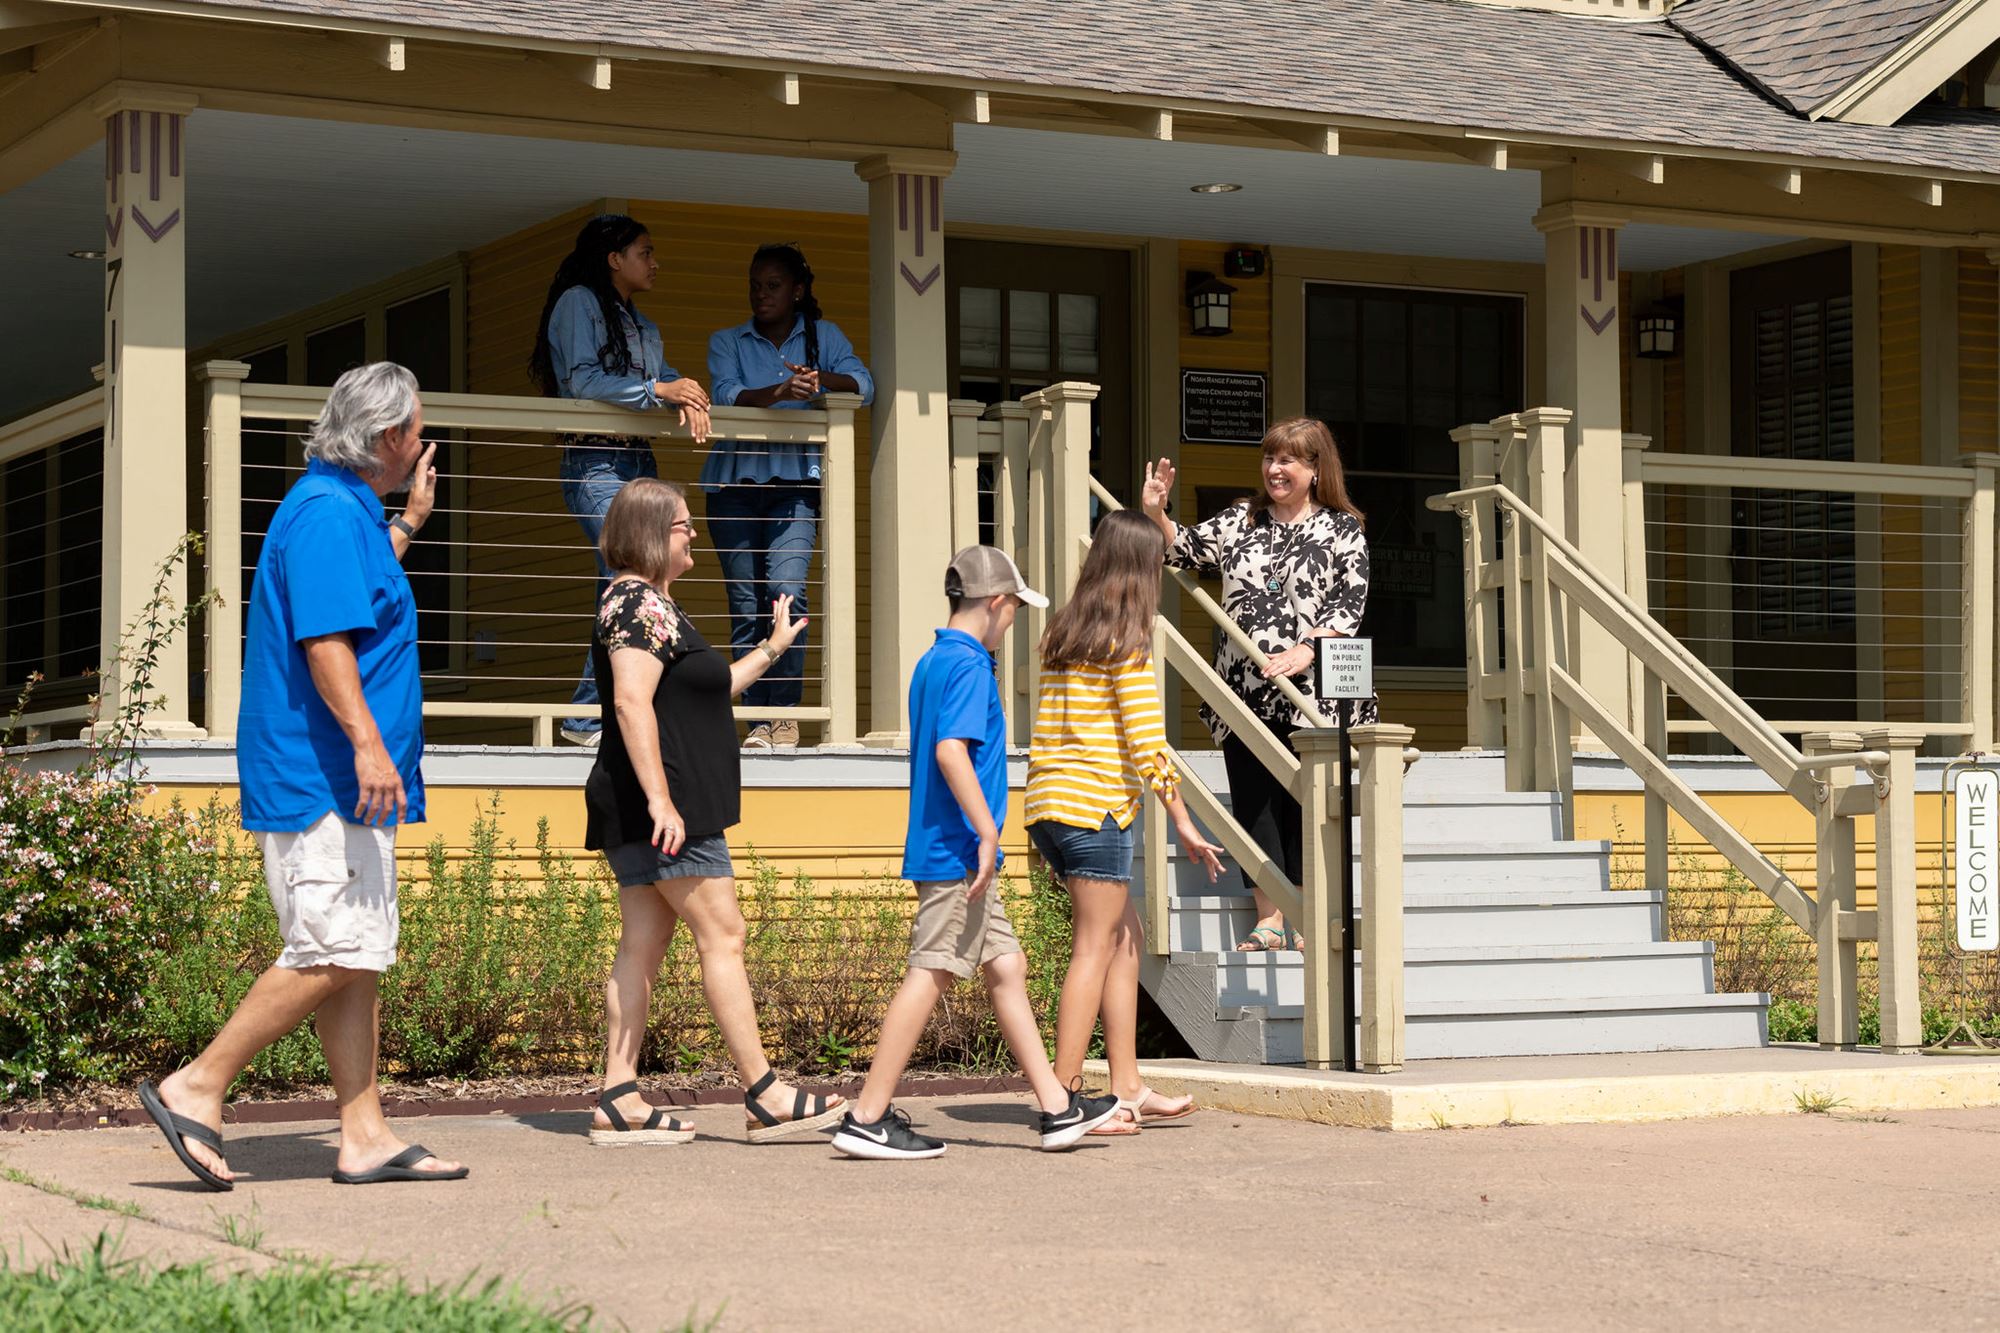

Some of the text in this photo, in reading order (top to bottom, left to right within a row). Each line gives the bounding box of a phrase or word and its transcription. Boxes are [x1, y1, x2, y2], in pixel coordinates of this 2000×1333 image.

[1190, 375, 1258, 386] NOAH RANGE FARMHOUSE
[1186, 387, 1209, 395] VISITORS
[1209, 388, 1231, 396] CENTER
[1243, 390, 1262, 398] OFFICE
[1331, 664, 1362, 672] PROPERTY
[1335, 685, 1360, 693] FACILITY
[1966, 783, 1988, 938] WELCOME
